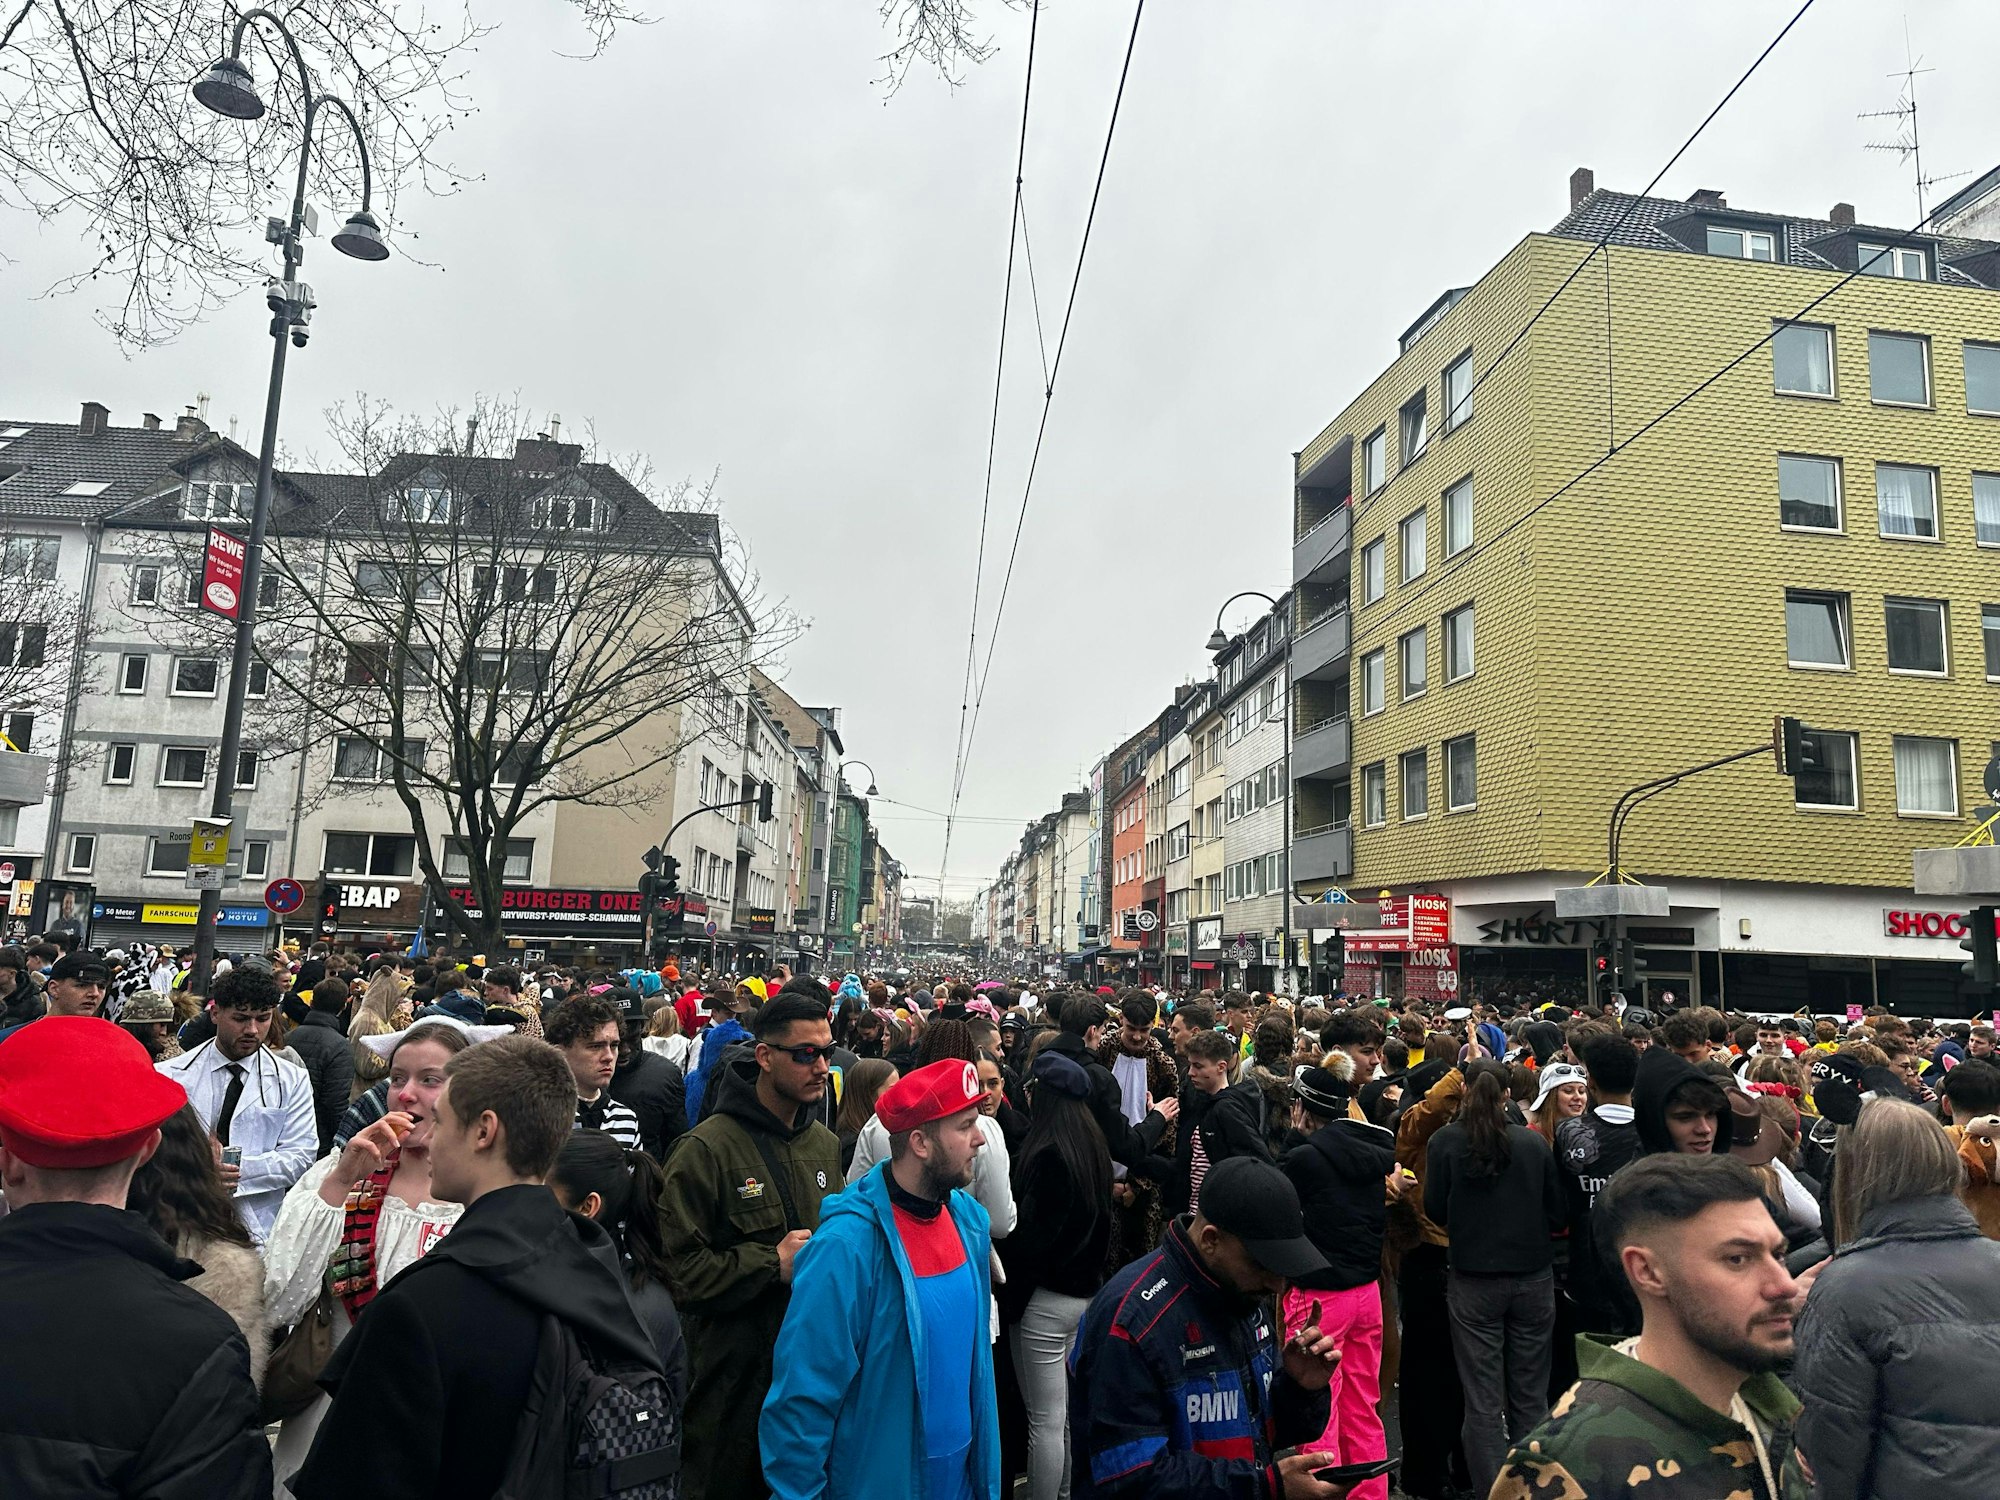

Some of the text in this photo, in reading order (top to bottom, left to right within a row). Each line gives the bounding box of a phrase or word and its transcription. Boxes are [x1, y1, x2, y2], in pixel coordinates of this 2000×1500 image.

[210, 531, 245, 561] REWE
[501, 890, 592, 910] BURGER
[599, 892, 645, 912] ONE
[1413, 898, 1447, 911] KIOSK
[115, 908, 136, 916] Meter
[149, 910, 198, 918] FAHRSCHULE
[1344, 950, 1378, 964] KIOSK
[1409, 948, 1452, 967] KIOSK
[965, 1066, 978, 1094] M
[1567, 1147, 1586, 1160] Y-3
[1186, 1389, 1239, 1424] BMW
